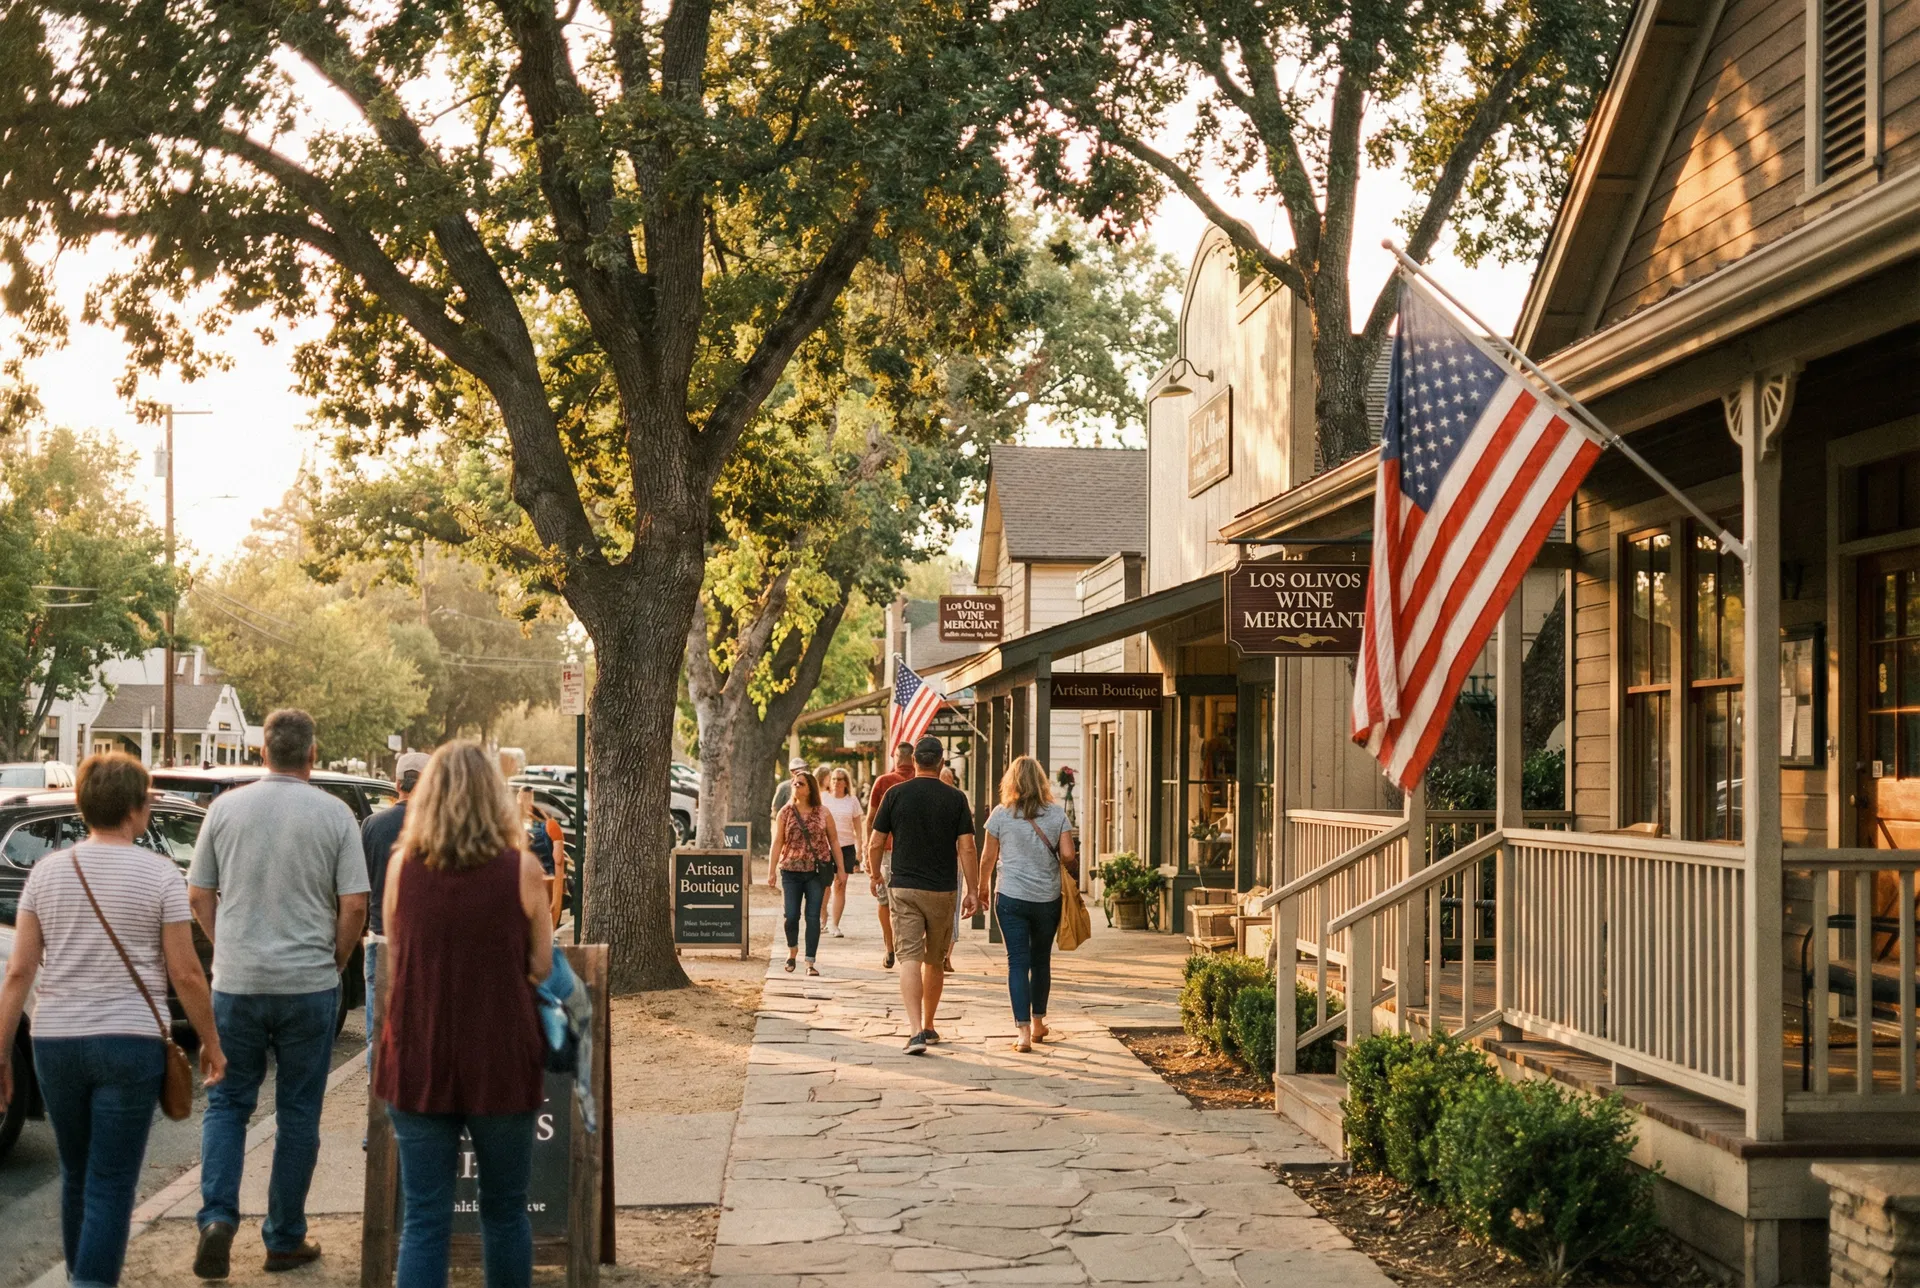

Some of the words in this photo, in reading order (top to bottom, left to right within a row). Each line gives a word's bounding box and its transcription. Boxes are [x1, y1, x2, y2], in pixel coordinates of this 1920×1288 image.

[1249, 572, 1286, 588] LOS
[1290, 572, 1361, 588] OLIVOS
[1275, 591, 1335, 609] WINE
[957, 610, 985, 620] WINE
[1243, 611, 1366, 629] MERCHANT
[943, 619, 1000, 630] MERCHANT
[1052, 683, 1099, 696] Artisan
[1102, 683, 1158, 699] Boutique
[685, 861, 734, 876] Artisan
[680, 879, 740, 897] Boutique
